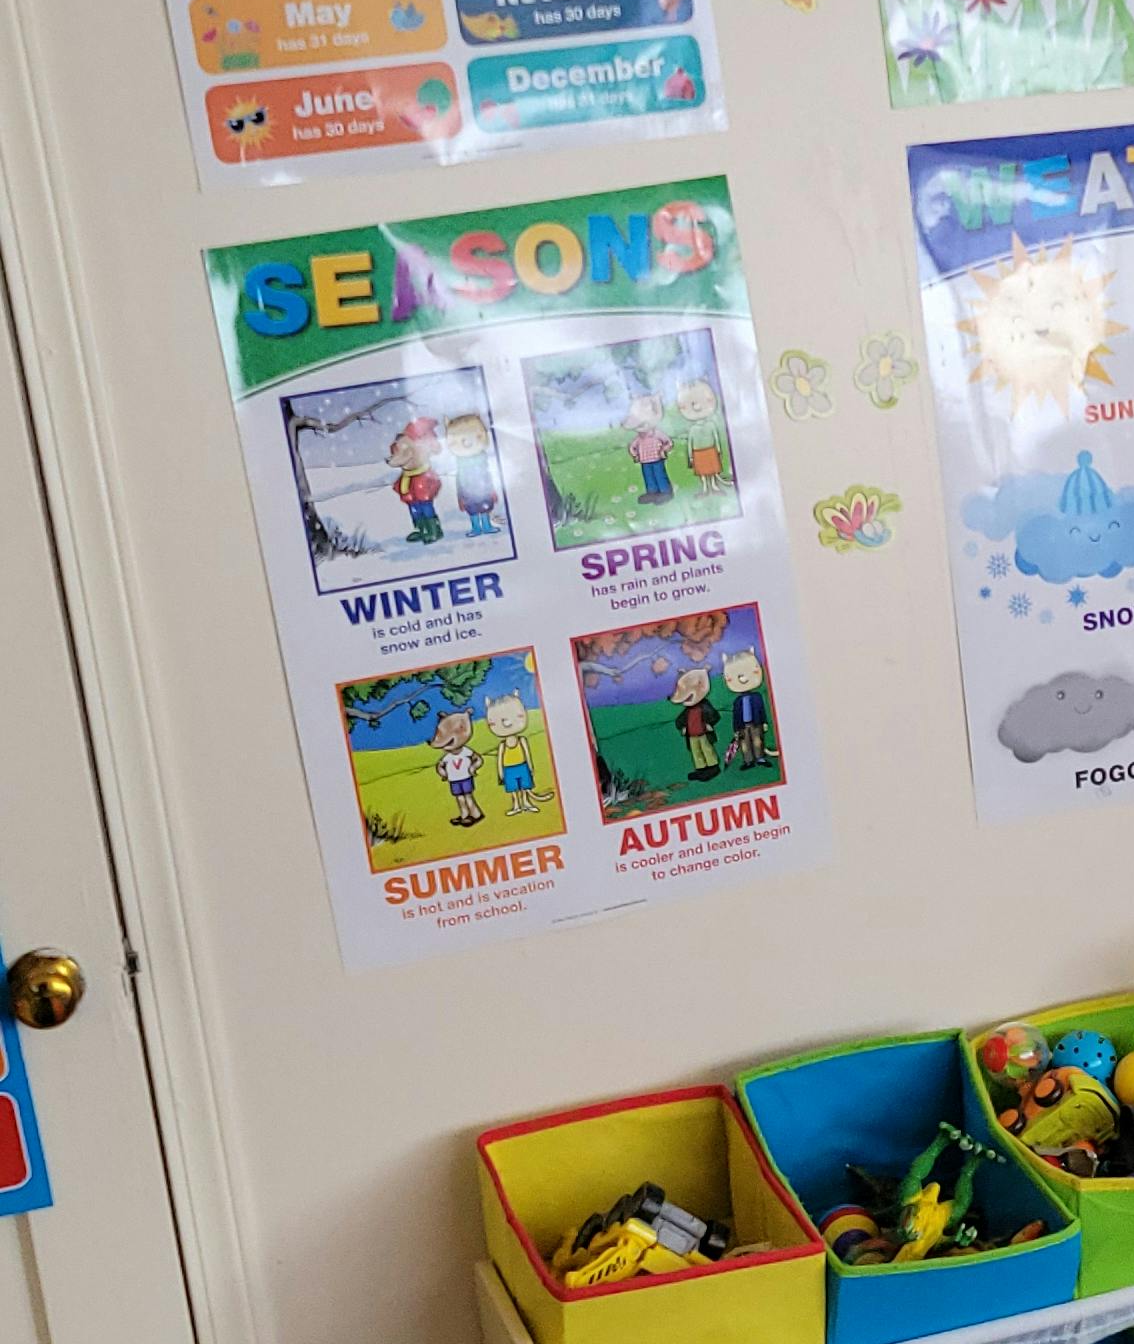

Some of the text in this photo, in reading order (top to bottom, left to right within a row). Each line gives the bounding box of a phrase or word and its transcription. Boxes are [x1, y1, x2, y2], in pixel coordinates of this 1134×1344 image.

[284, 0, 352, 29] May
[505, 55, 666, 93] December
[294, 88, 374, 118] June
[243, 199, 715, 338] SEASONS
[580, 530, 726, 581] SPRING
[591, 562, 724, 598] has rain and plants
[610, 582, 711, 611] begin to grow.
[339, 572, 504, 626] WINTER
[372, 609, 483, 641] is cold and has
[380, 625, 483, 657] snow and ice.
[619, 795, 782, 856] AUTUMN
[615, 824, 792, 874] is cooler and leaves begin
[651, 846, 761, 881] to change color.
[383, 844, 565, 906] SUMMER
[402, 876, 556, 921] is hot and is vacation
[436, 912, 471, 929] from
[475, 899, 527, 923] school.
